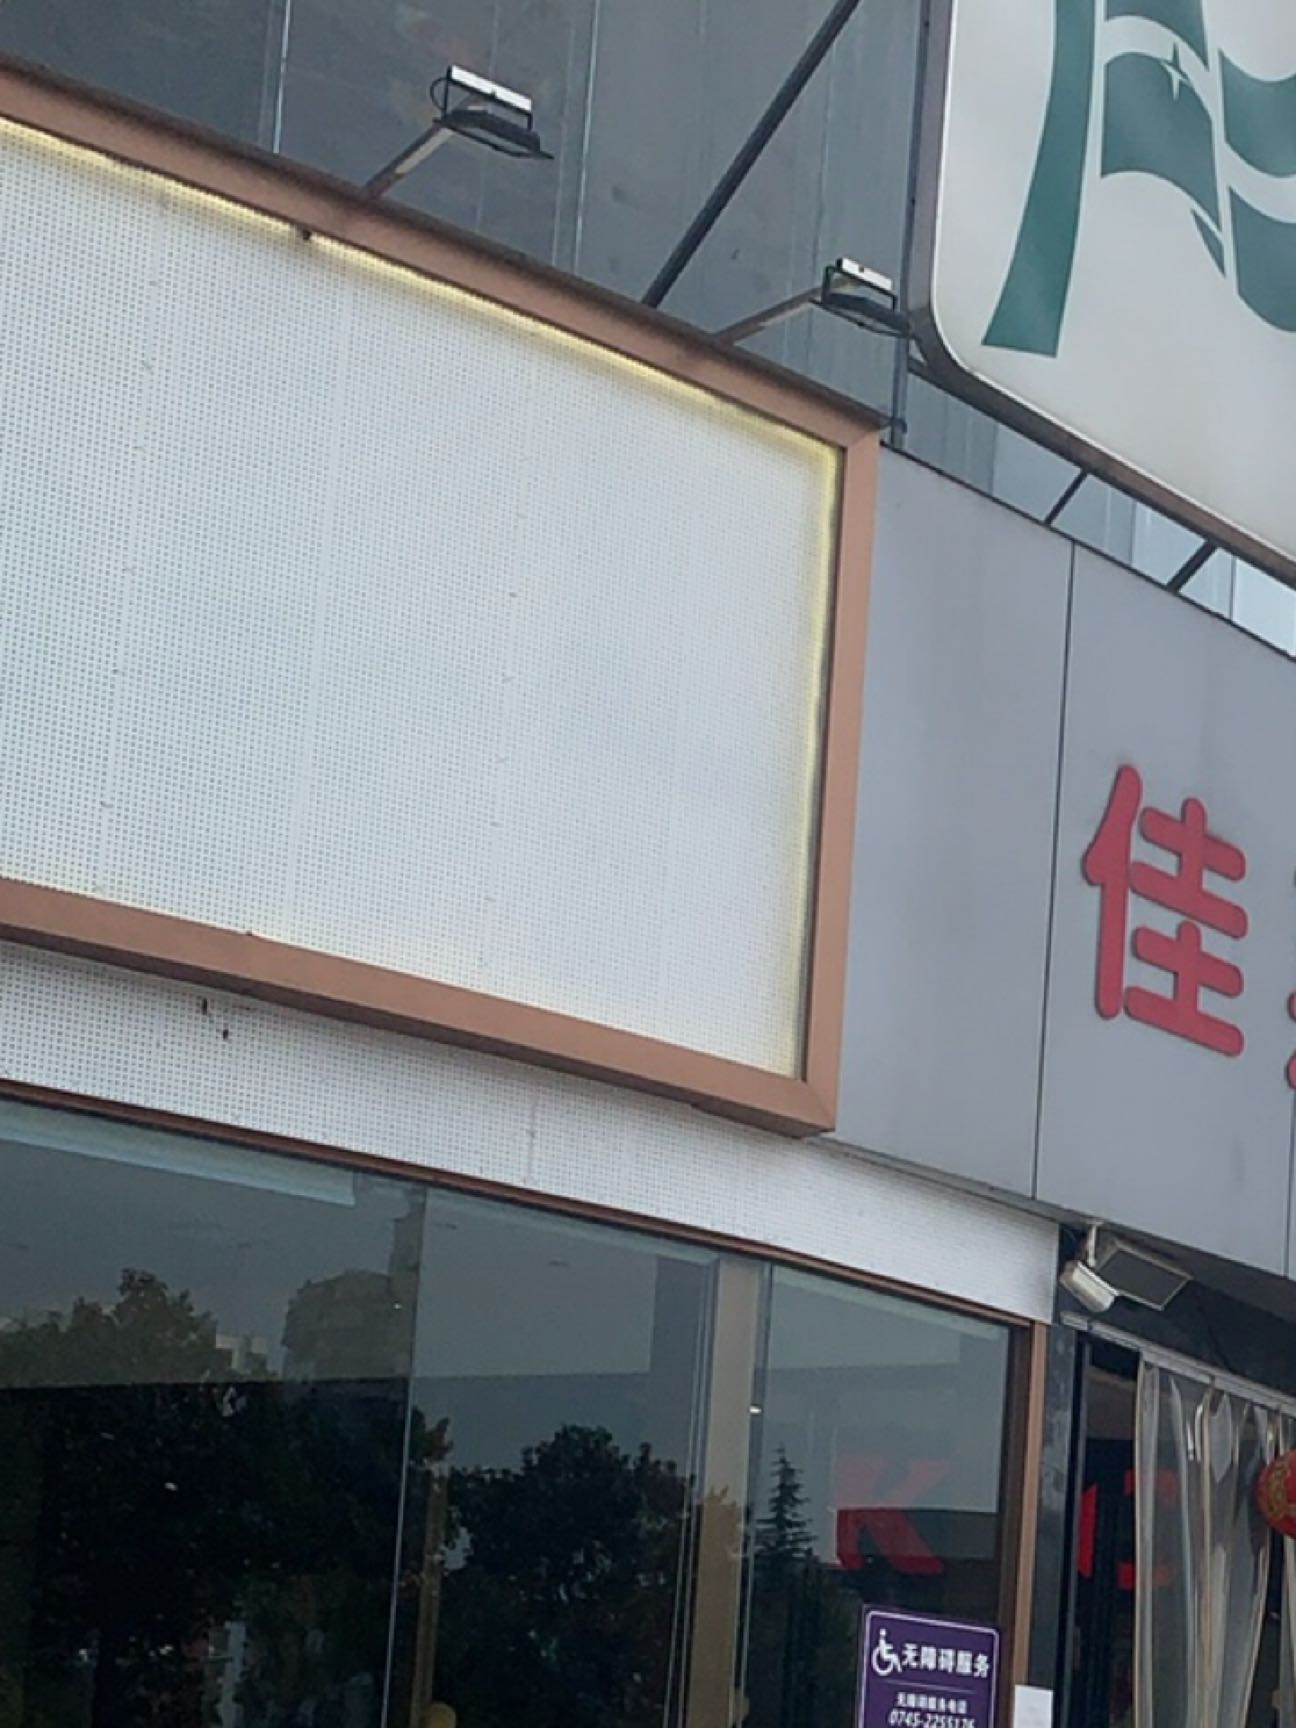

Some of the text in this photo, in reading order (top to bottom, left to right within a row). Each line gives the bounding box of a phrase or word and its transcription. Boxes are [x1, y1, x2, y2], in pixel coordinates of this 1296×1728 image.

[902, 1643, 989, 1678] 无障碍服务
